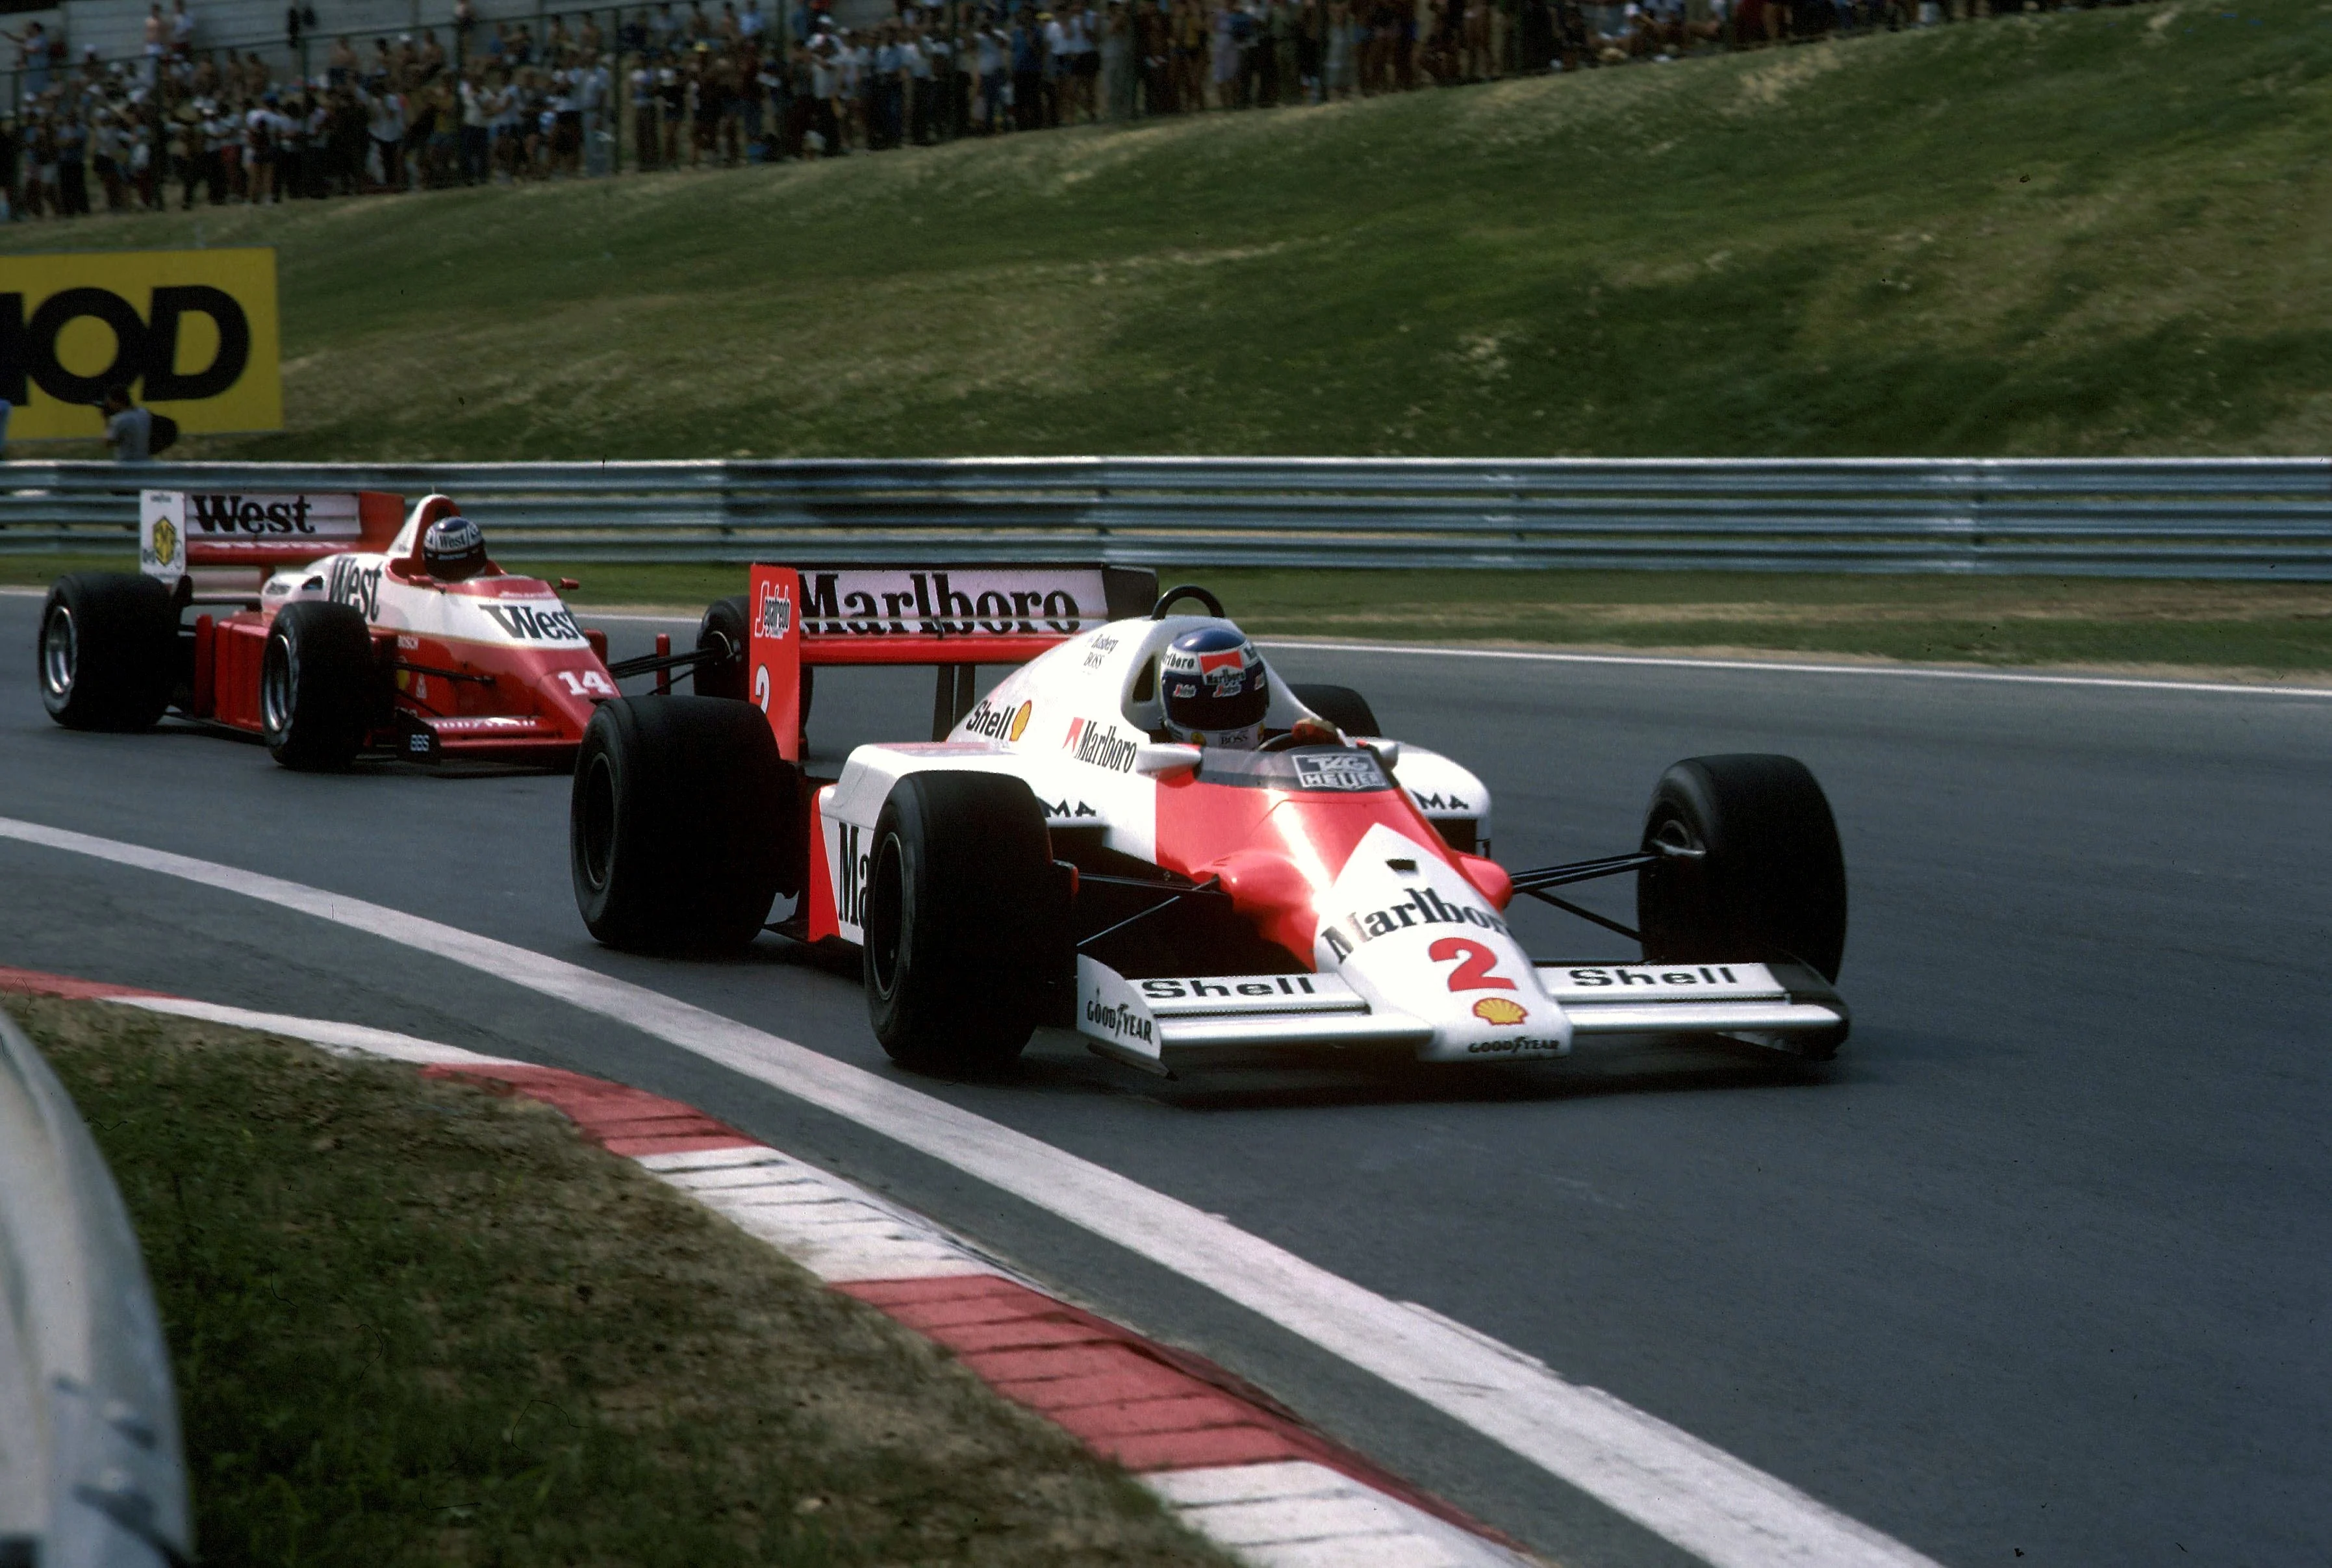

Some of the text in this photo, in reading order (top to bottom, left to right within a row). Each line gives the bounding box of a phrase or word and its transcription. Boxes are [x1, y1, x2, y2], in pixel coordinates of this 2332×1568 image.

[192, 494, 316, 534] West
[439, 534, 466, 548] West
[328, 555, 383, 624] West
[798, 573, 1081, 635] Marlboro
[478, 601, 586, 640] West
[557, 670, 615, 696] 14
[755, 662, 770, 714] 2
[965, 699, 1016, 740] Shell
[1073, 720, 1137, 774] Marlboro
[1428, 937, 1519, 993] 2
[1568, 966, 1738, 987] Shell
[1142, 976, 1316, 999] Shell
